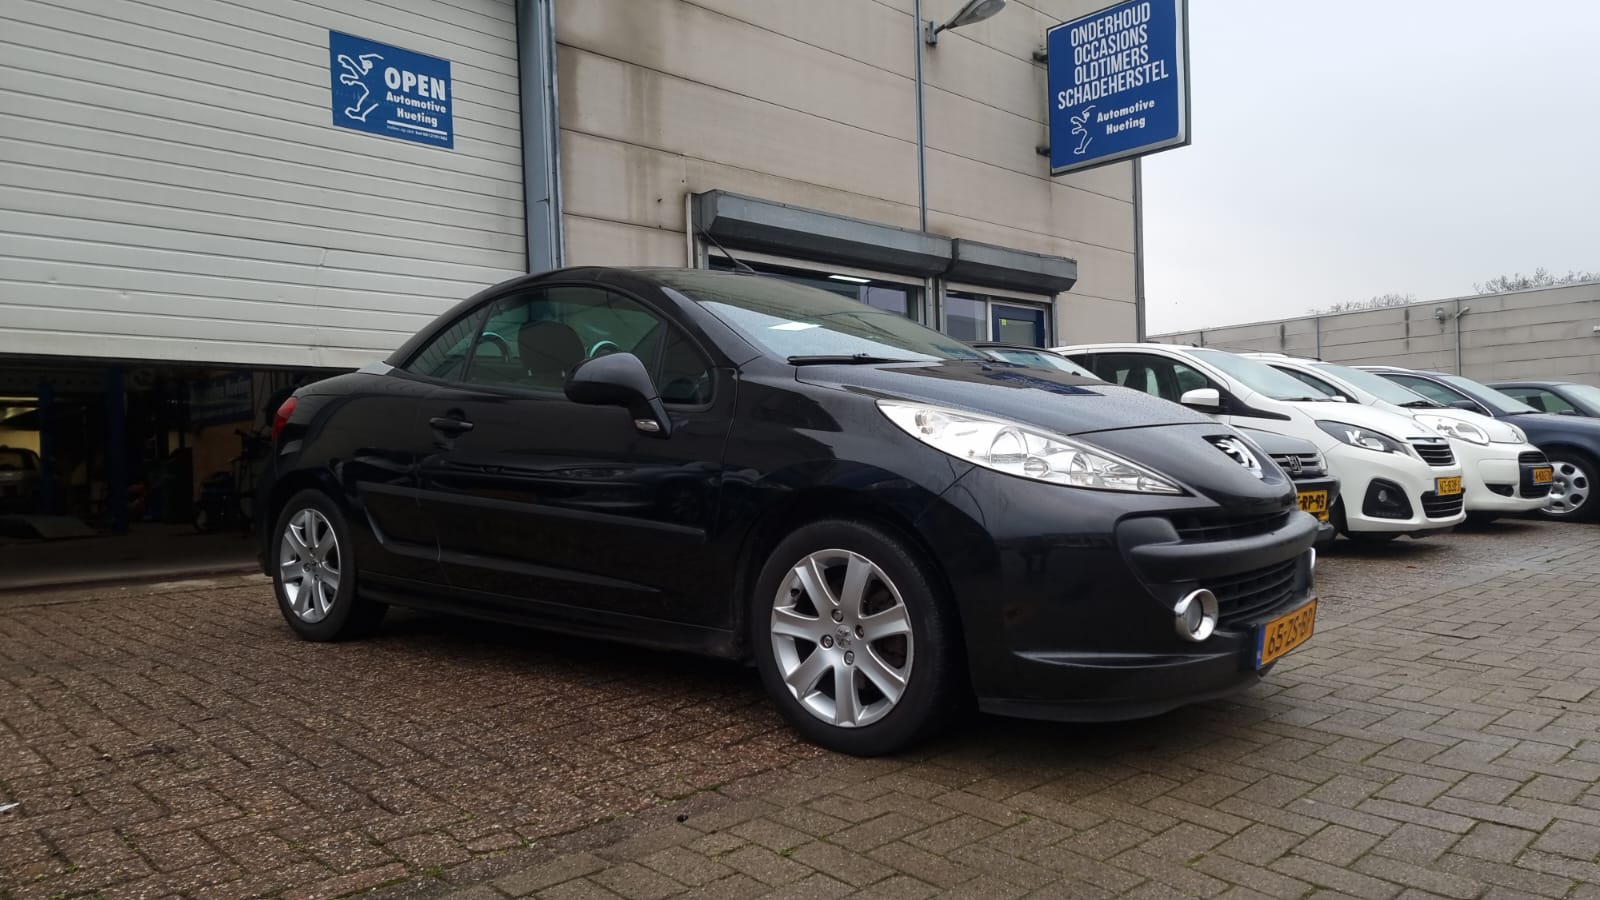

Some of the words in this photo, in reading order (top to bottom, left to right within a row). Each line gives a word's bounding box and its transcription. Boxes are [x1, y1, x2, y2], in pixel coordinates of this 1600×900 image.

[1070, 2, 1150, 47] ONDERHOUD
[1074, 24, 1148, 65] OCCASIONS
[1074, 45, 1149, 85] OLDTIMERS
[384, 67, 446, 101] OPEN
[1057, 59, 1169, 110] SCHADEHERSTEL
[386, 91, 447, 113] Automotive
[396, 107, 438, 128] Hueting
[1096, 99, 1155, 123] Automotive
[1106, 117, 1146, 135] Hueting
